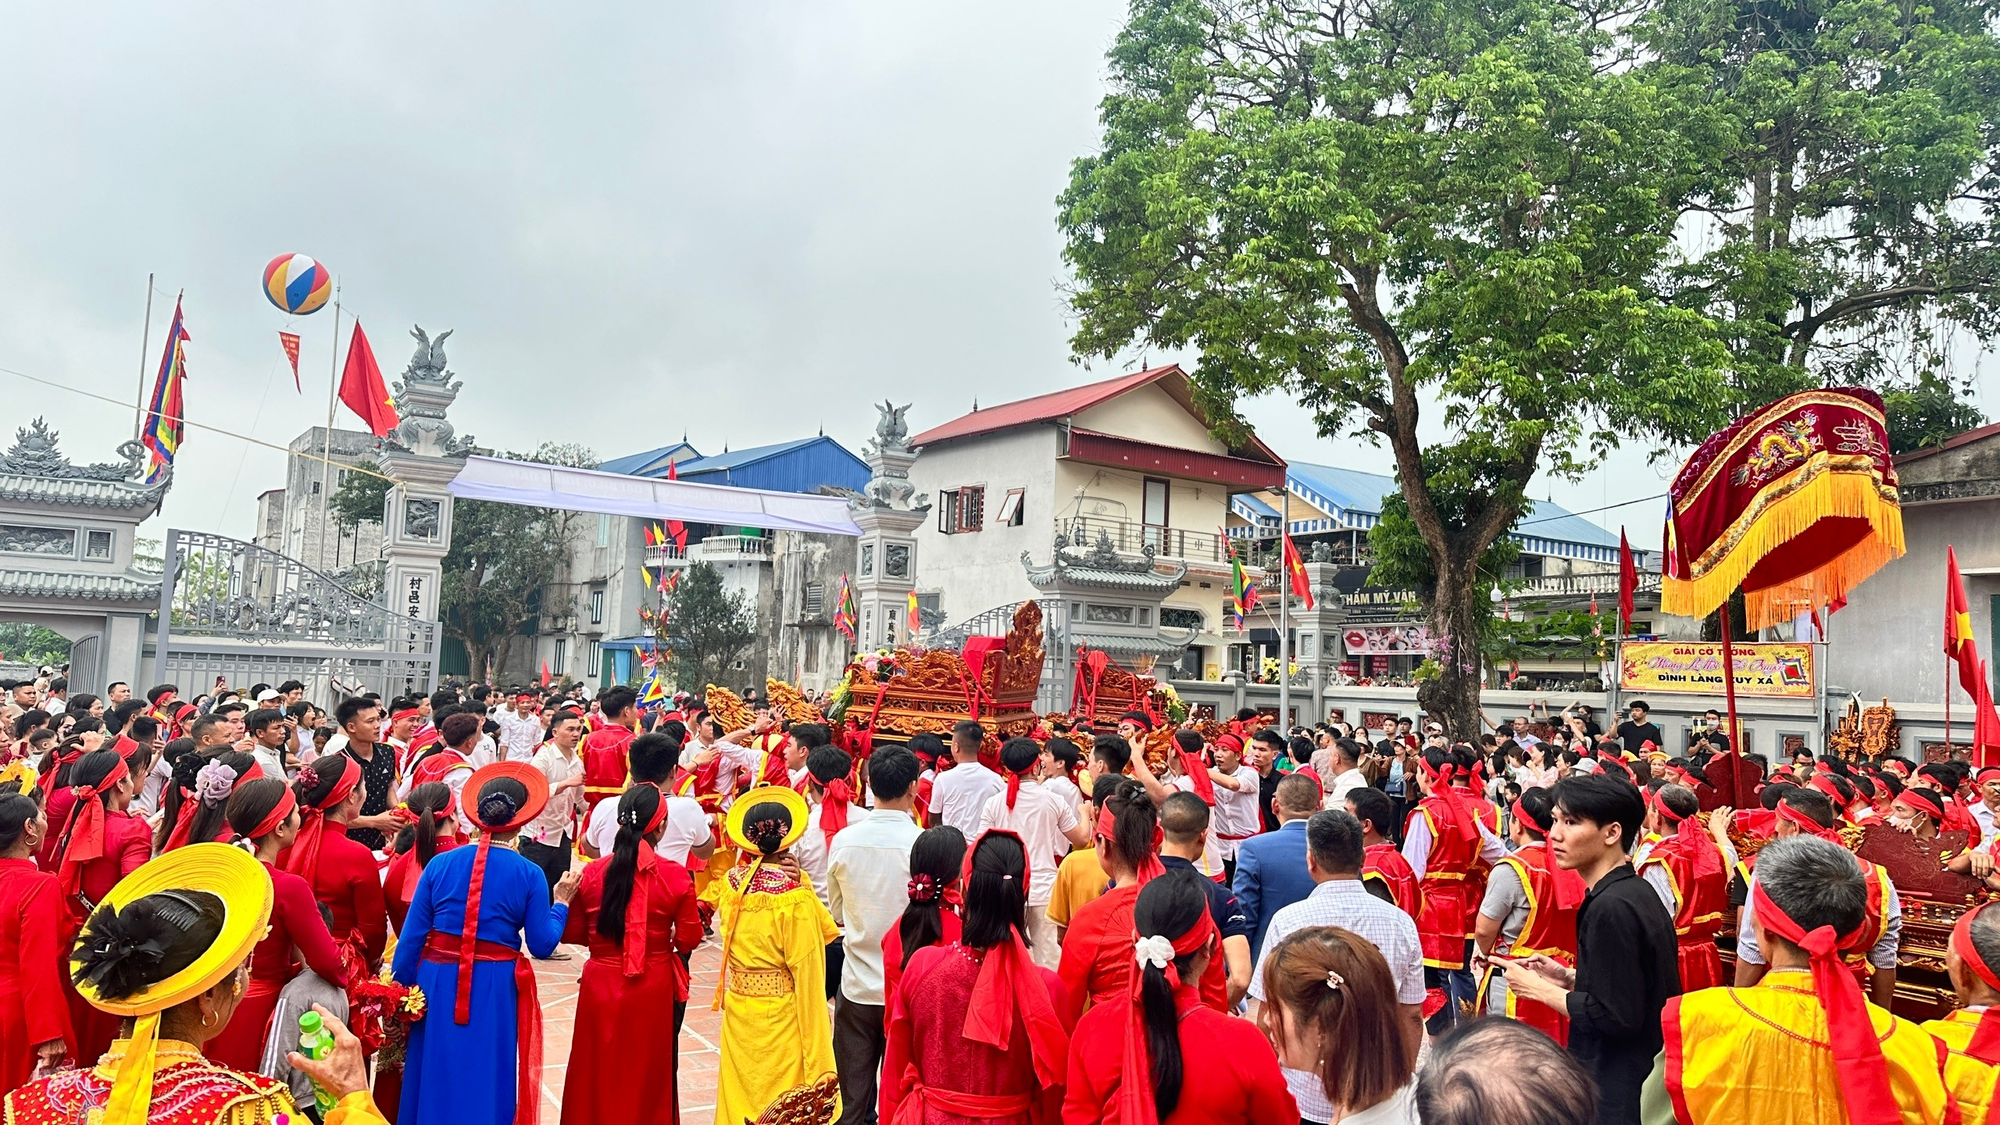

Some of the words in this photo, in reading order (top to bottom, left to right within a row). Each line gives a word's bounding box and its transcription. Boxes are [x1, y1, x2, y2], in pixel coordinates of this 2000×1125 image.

[1345, 588, 1370, 606] HẨM
[1673, 646, 1695, 655] GIẢI
[1698, 646, 1714, 655] CỜ
[1717, 646, 1756, 656] TỚNG
[1658, 672, 1686, 682] ĐÌNH
[1691, 673, 1723, 683] LÀNG
[1757, 675, 1774, 685] XÁ
